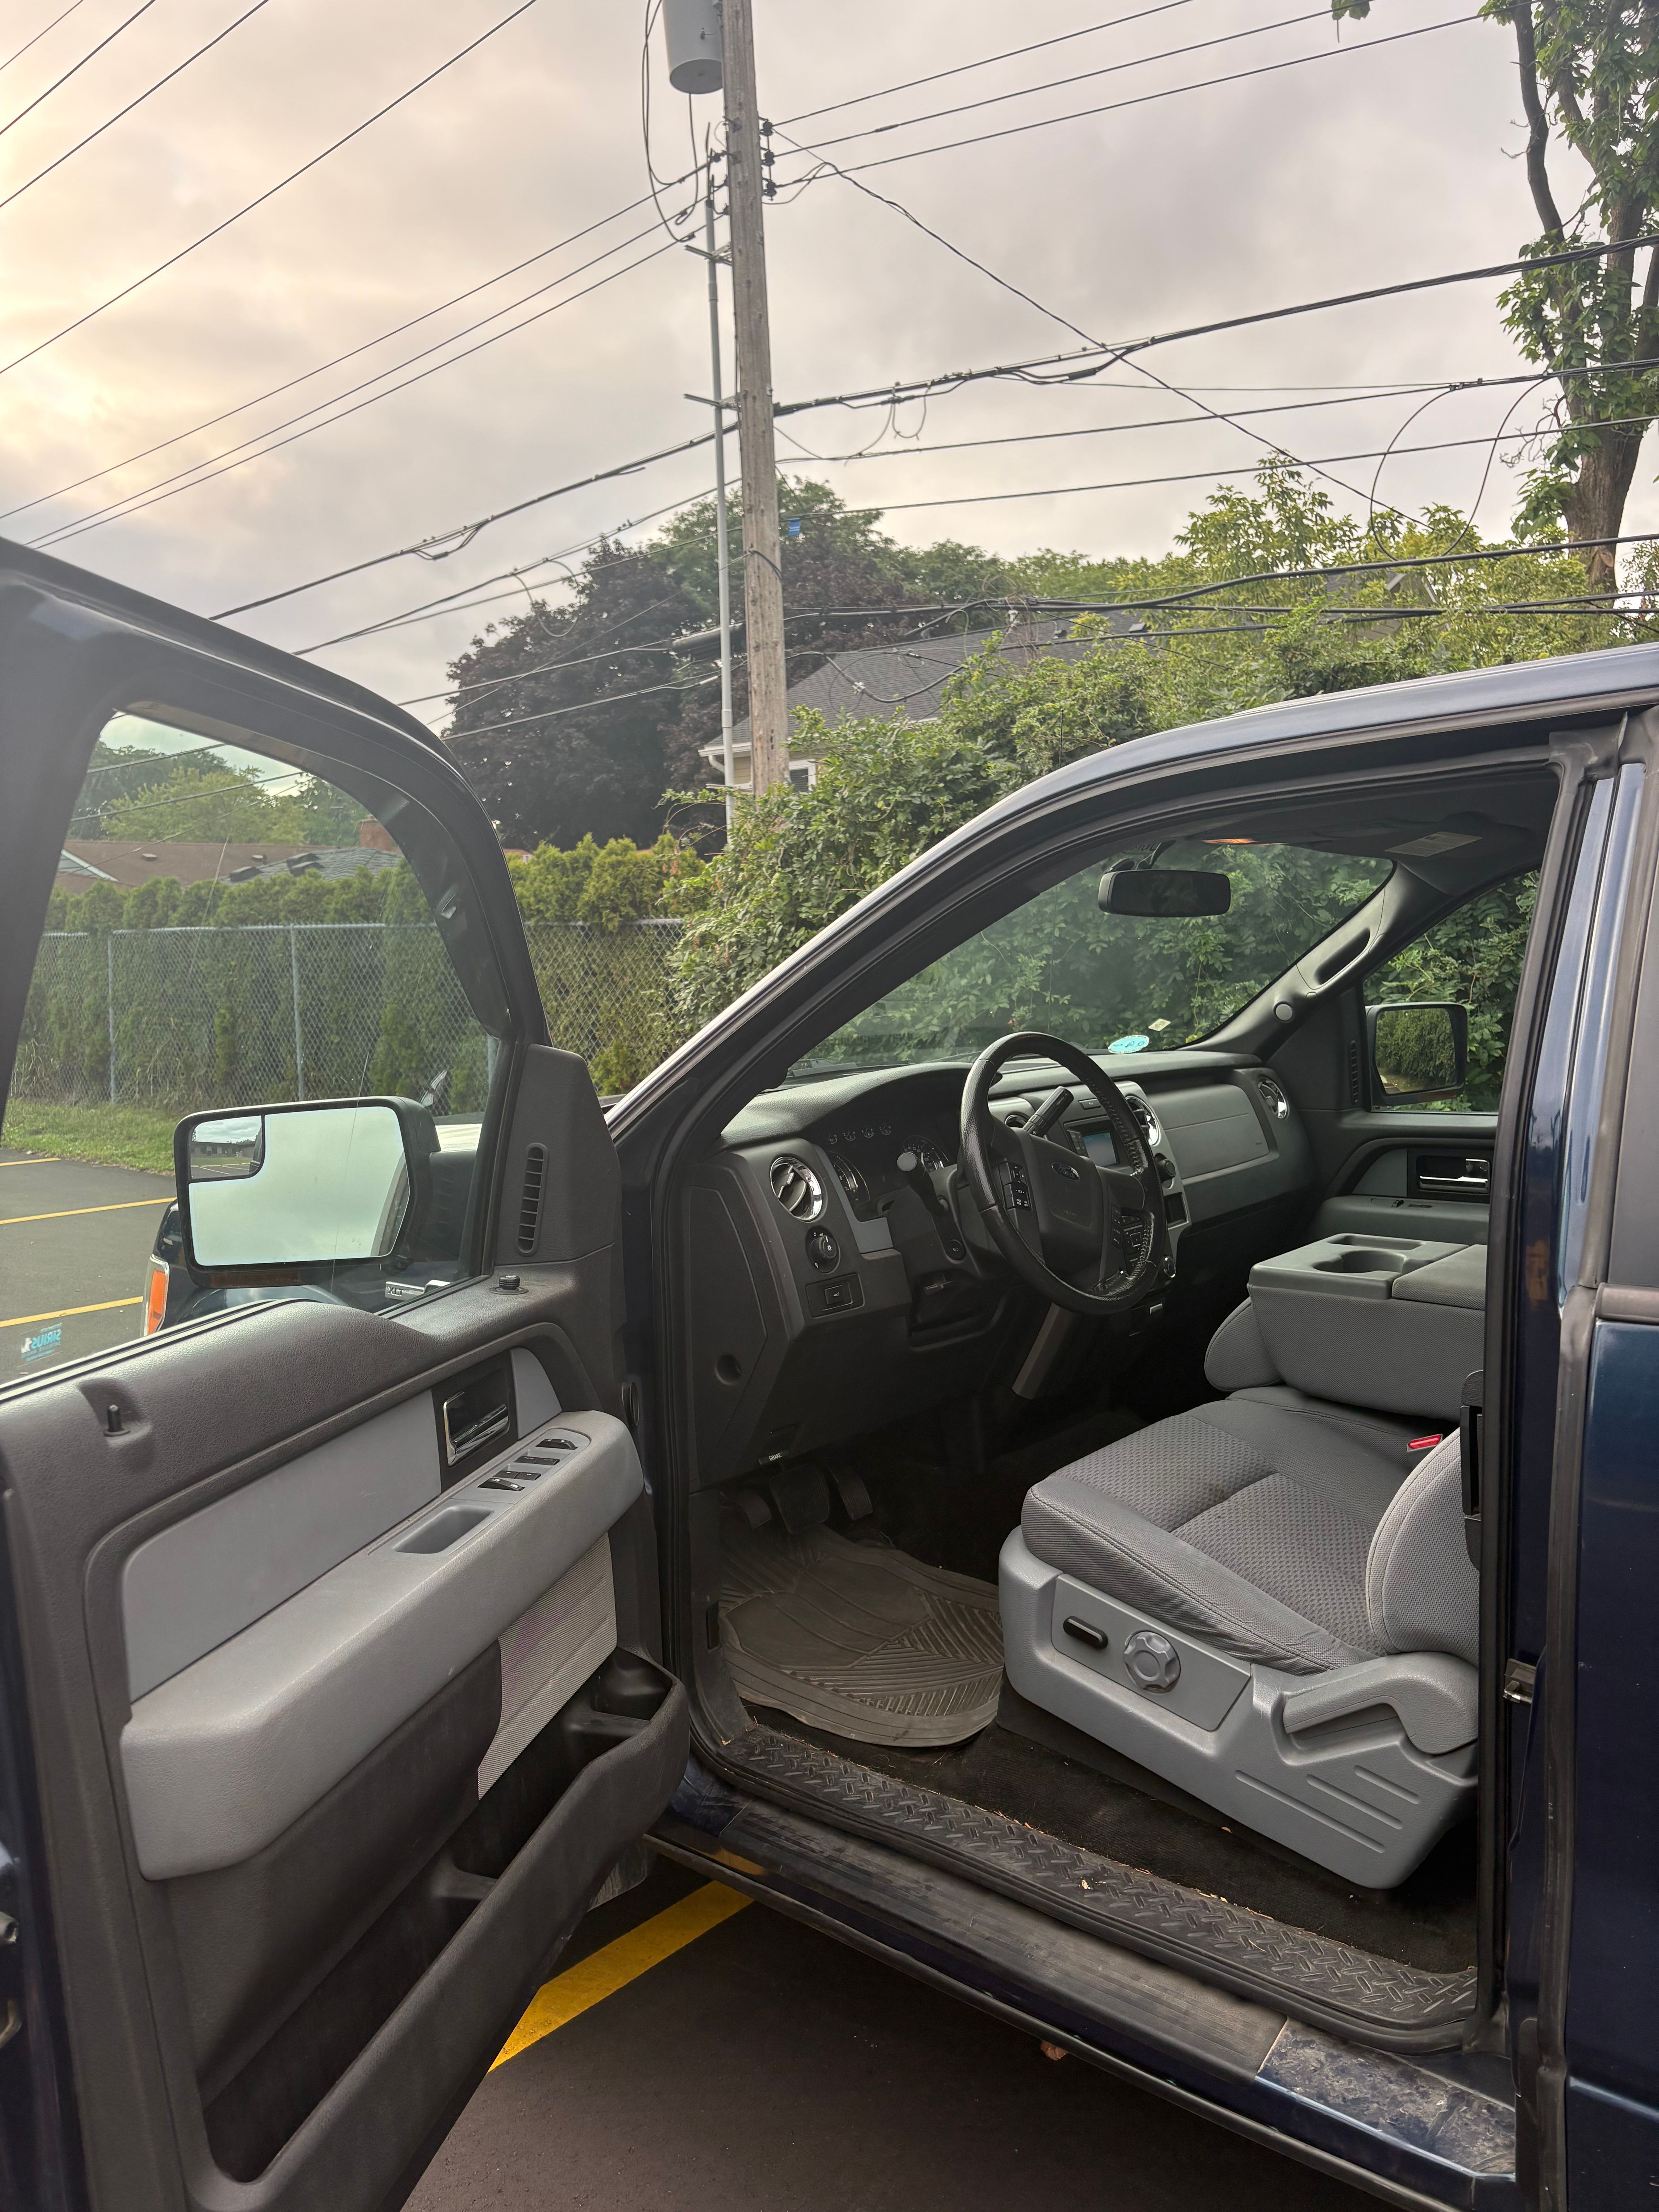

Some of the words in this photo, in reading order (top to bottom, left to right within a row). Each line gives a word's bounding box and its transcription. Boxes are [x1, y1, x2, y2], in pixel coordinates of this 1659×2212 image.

[1058, 1164, 1075, 1178] Ford
[388, 1286, 405, 1297] XLT
[769, 1453, 782, 1461] BRAKE
